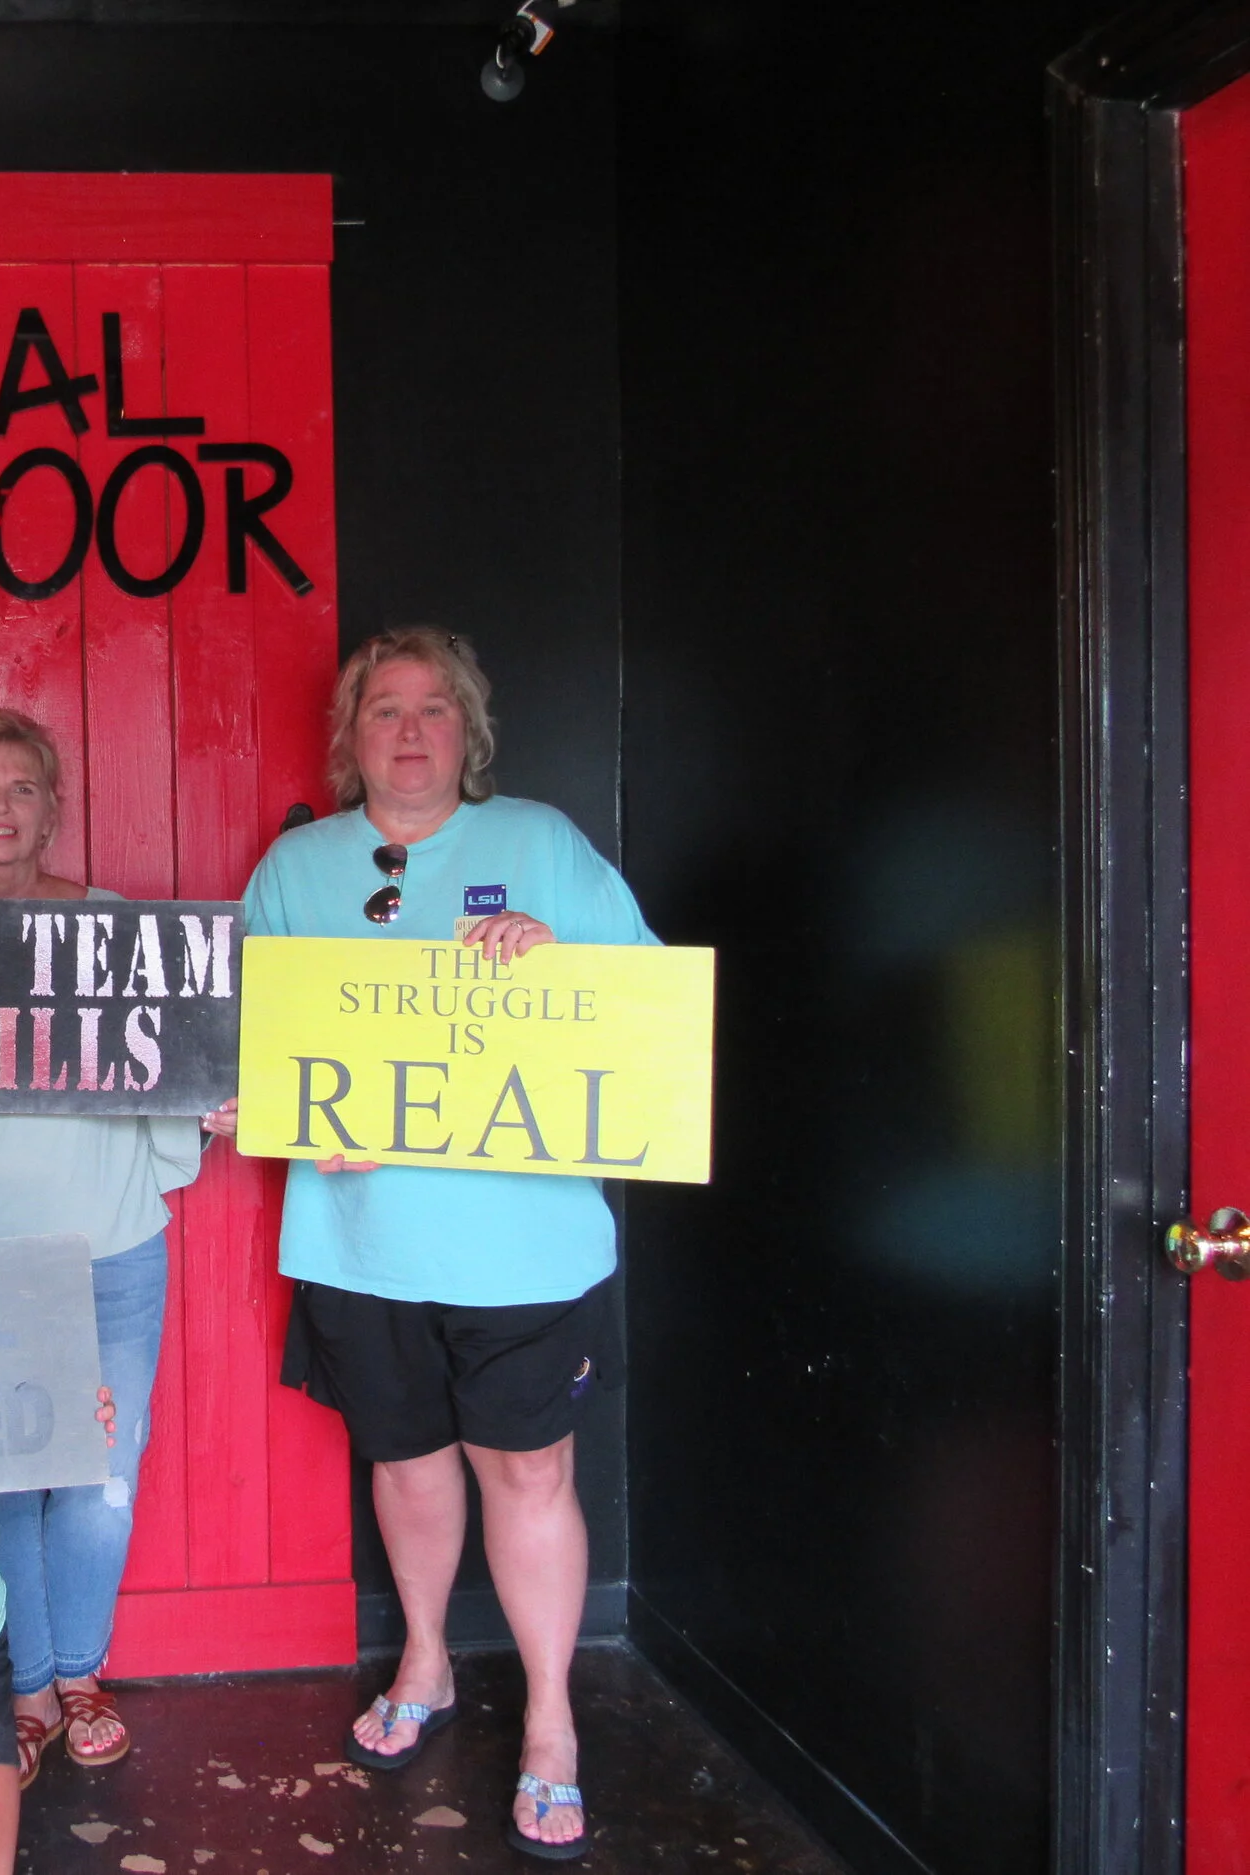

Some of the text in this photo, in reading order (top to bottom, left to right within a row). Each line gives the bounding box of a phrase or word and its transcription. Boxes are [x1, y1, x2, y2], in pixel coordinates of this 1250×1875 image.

[468, 894, 502, 905] LSU
[22, 913, 234, 998] TEAM
[421, 948, 514, 981] THE
[339, 981, 598, 1022] STRUGGLE
[446, 1022, 486, 1055] IS
[286, 1055, 650, 1167] REAL
